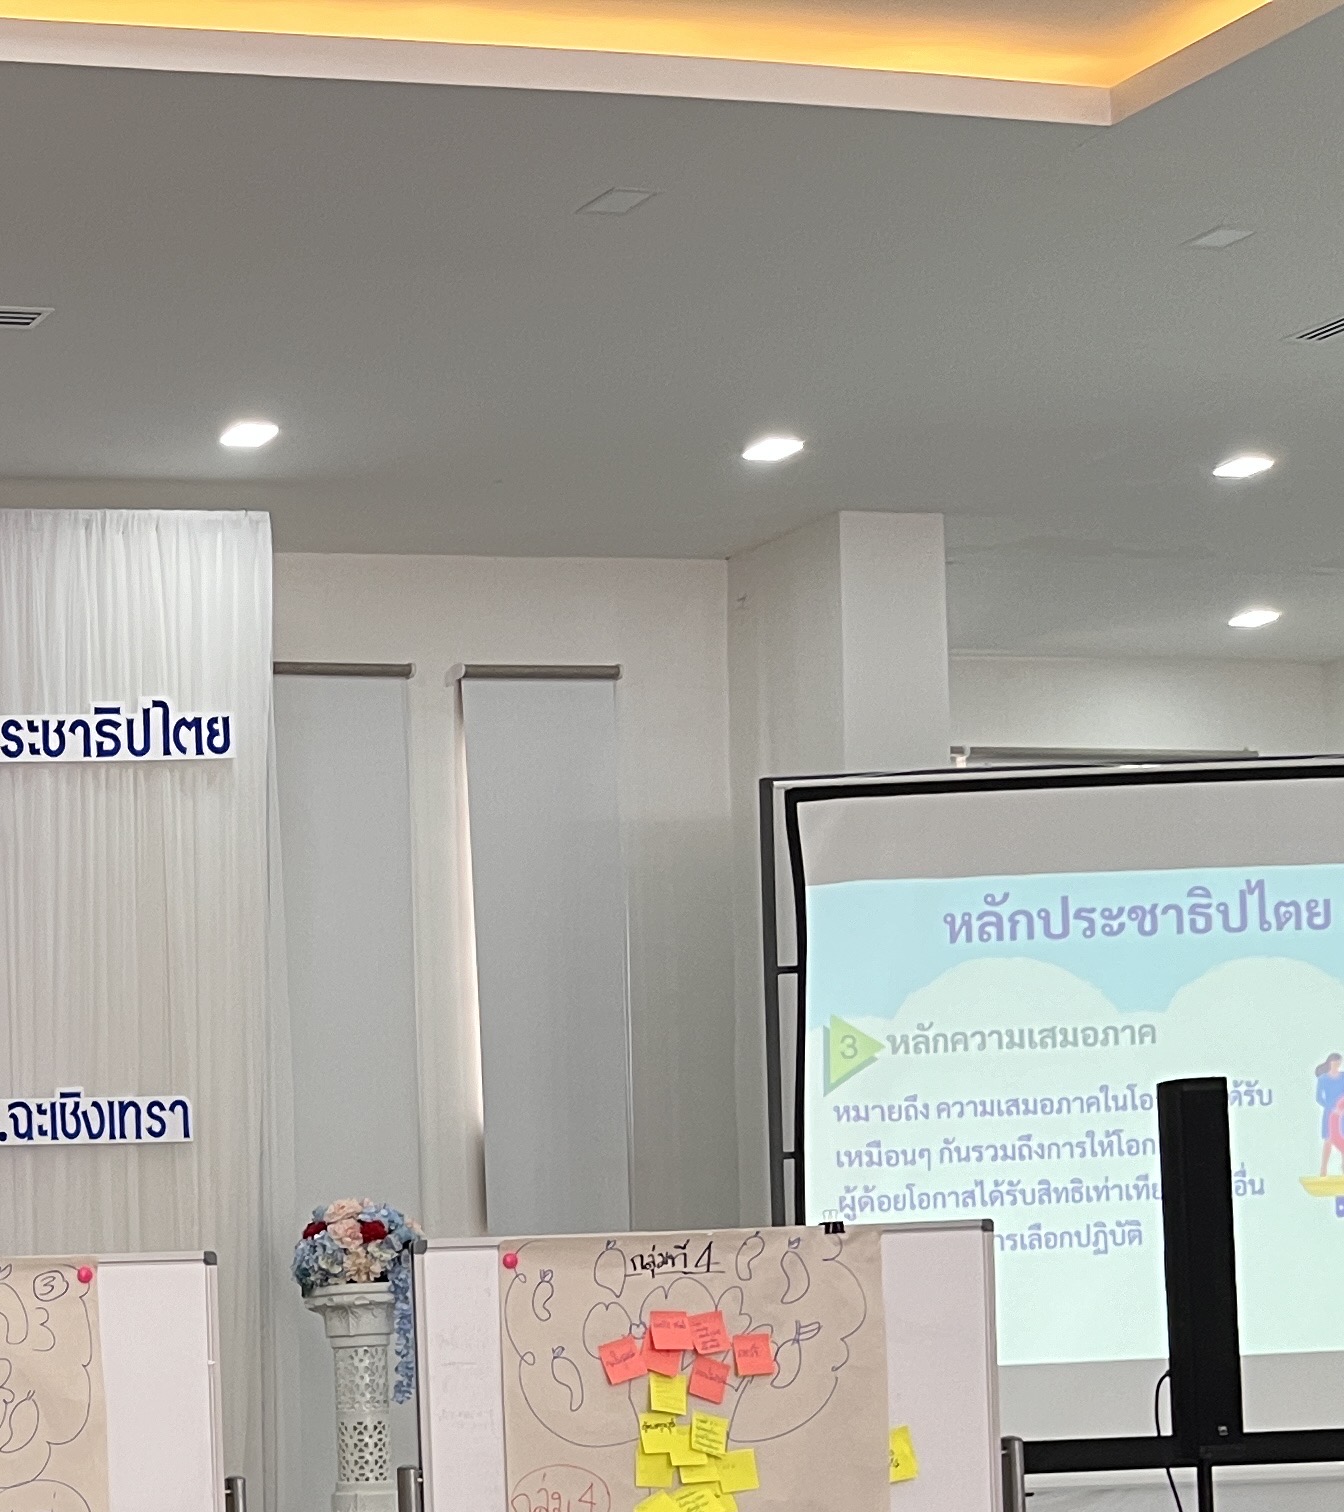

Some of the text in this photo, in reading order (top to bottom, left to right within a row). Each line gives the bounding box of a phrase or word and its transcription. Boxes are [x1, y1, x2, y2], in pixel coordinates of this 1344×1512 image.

[943, 878, 1332, 945] หลักประชาธิปไตย
[838, 1021, 1157, 1060] 3 หลักความเสมอภาค
[832, 1095, 930, 1127] หมายถึง
[630, 1238, 691, 1279] กลุ่มที่
